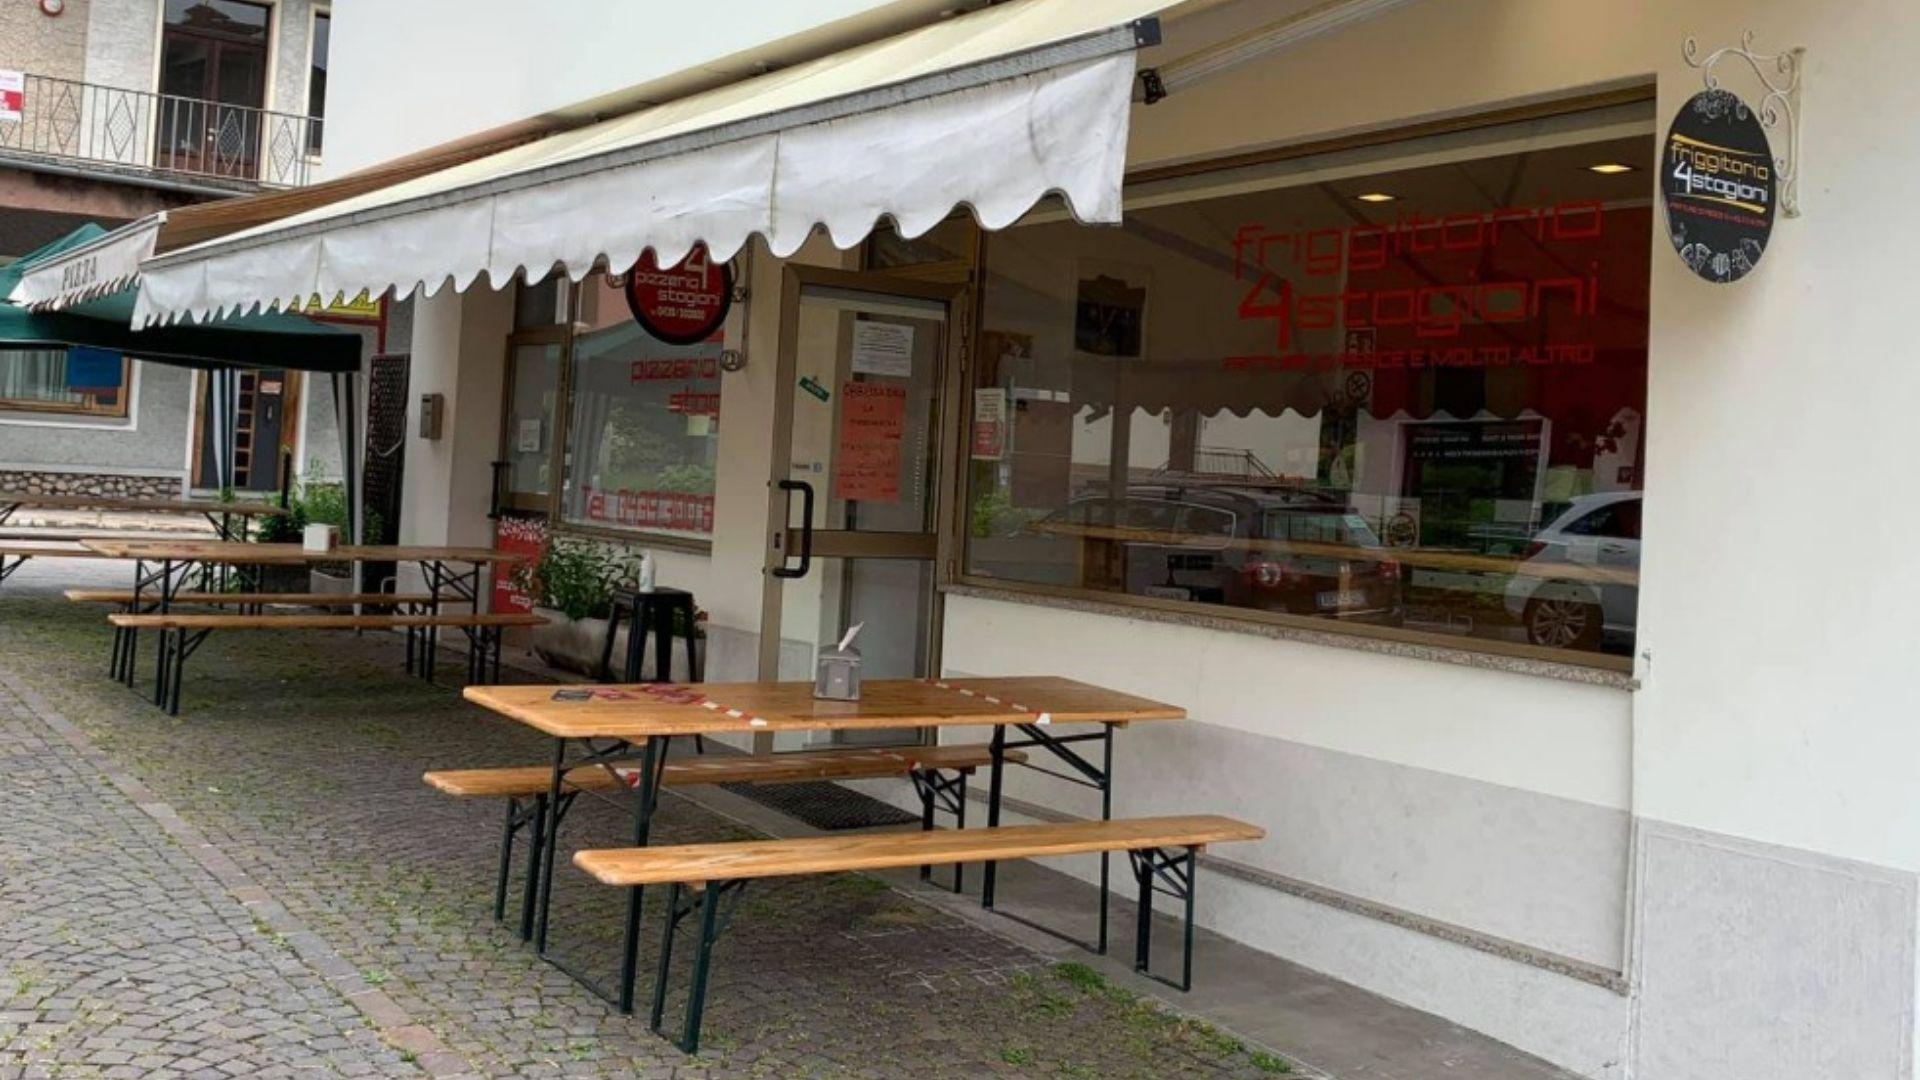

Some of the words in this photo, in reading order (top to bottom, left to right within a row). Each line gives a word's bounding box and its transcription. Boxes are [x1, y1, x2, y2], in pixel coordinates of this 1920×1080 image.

[62, 256, 98, 291] PIZZA
[1431, 346, 1511, 366] MOLTO
[1518, 343, 1594, 365] ALTRO
